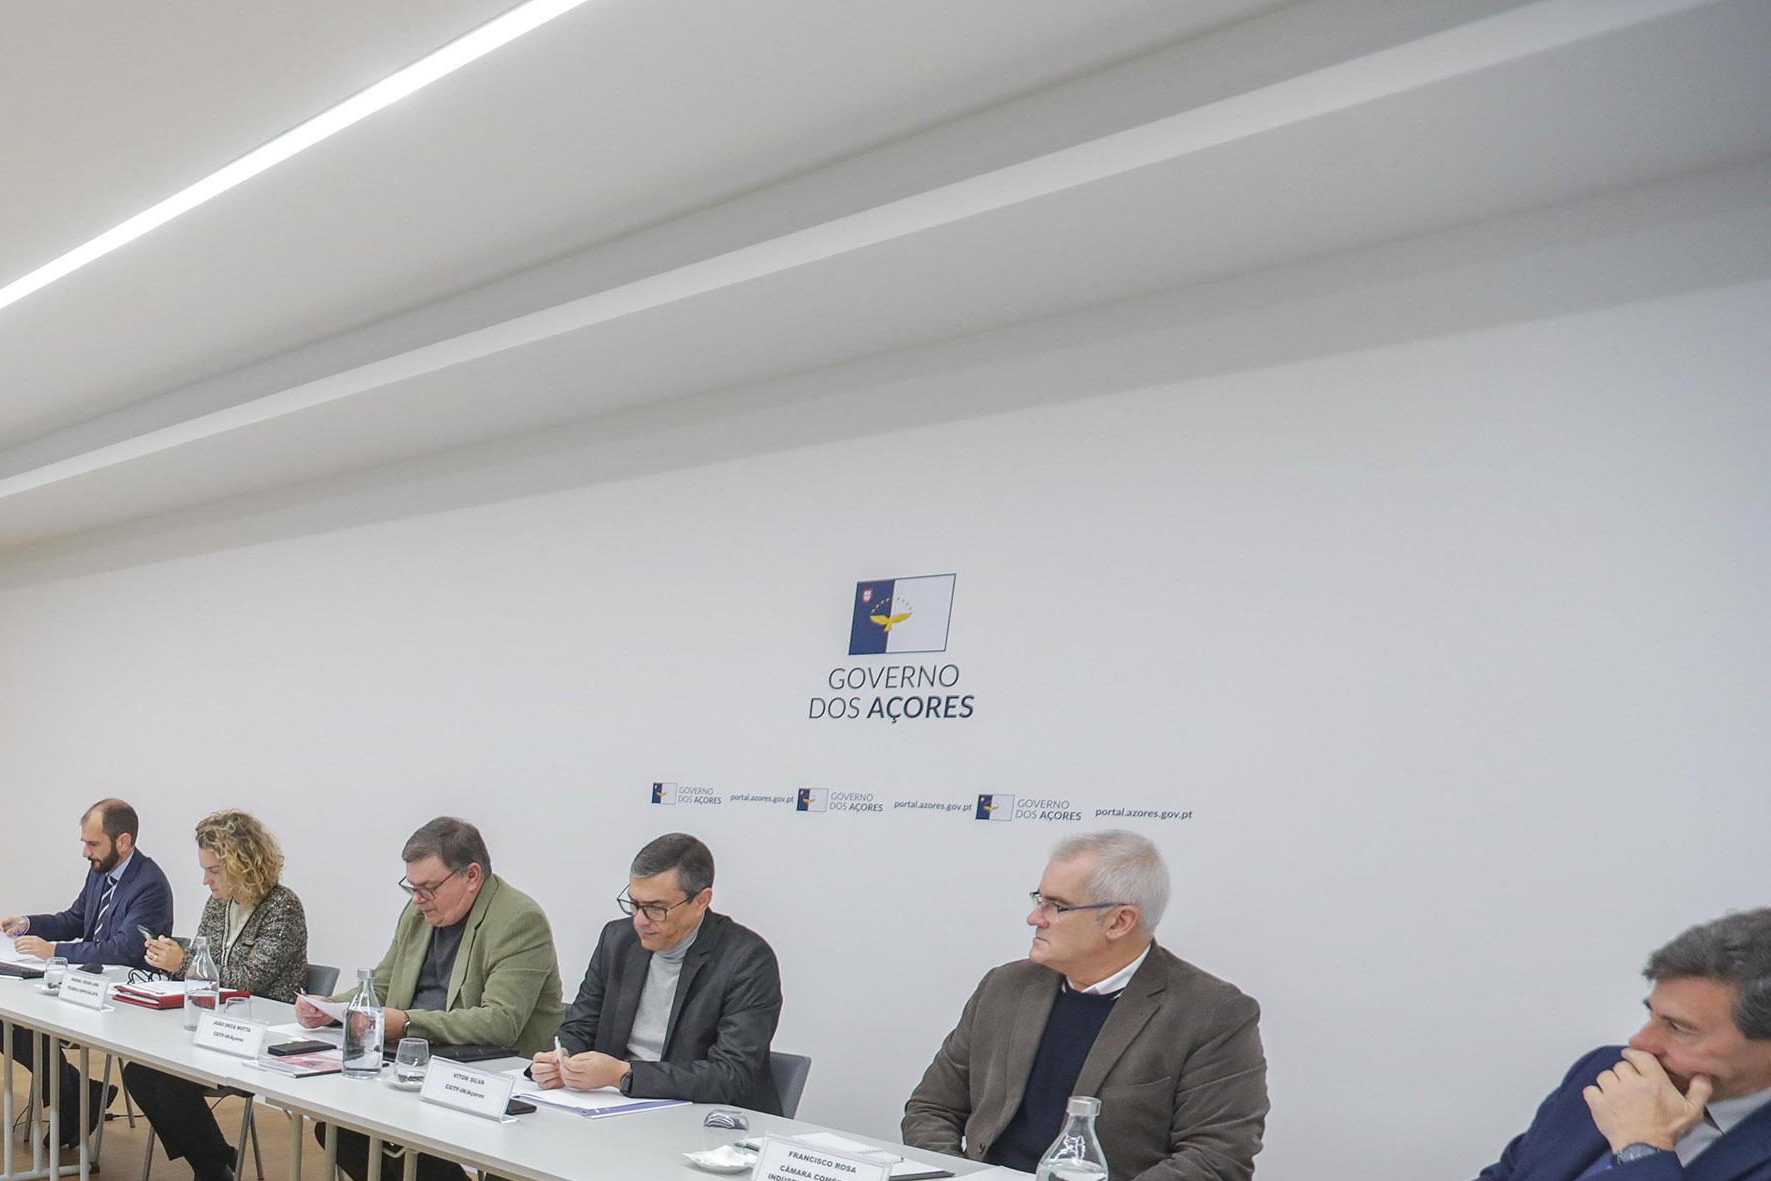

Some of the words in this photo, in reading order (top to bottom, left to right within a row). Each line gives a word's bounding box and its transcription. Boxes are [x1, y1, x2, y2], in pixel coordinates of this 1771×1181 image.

[828, 664, 960, 690] GOVERNO
[808, 697, 861, 719] DOS
[866, 695, 975, 724] AÇORES
[678, 786, 714, 795] GOVERNO
[677, 795, 692, 803] DOS
[693, 796, 722, 805] AÇORES
[730, 793, 795, 804] portal.azores.gov.pt
[830, 792, 874, 801] GOVERNO
[829, 802, 848, 810] DOS
[848, 802, 884, 812] AÇORES
[893, 800, 972, 812] portal.azores.gov.pt
[1017, 799, 1070, 809] GOVERNO
[1015, 809, 1038, 819] DOS
[1039, 811, 1082, 821] AÇORES
[1094, 807, 1193, 820] portal.azores.gov.pt
[788, 1150, 833, 1168] FRANCISCO
[834, 1162, 857, 1174] ROSA
